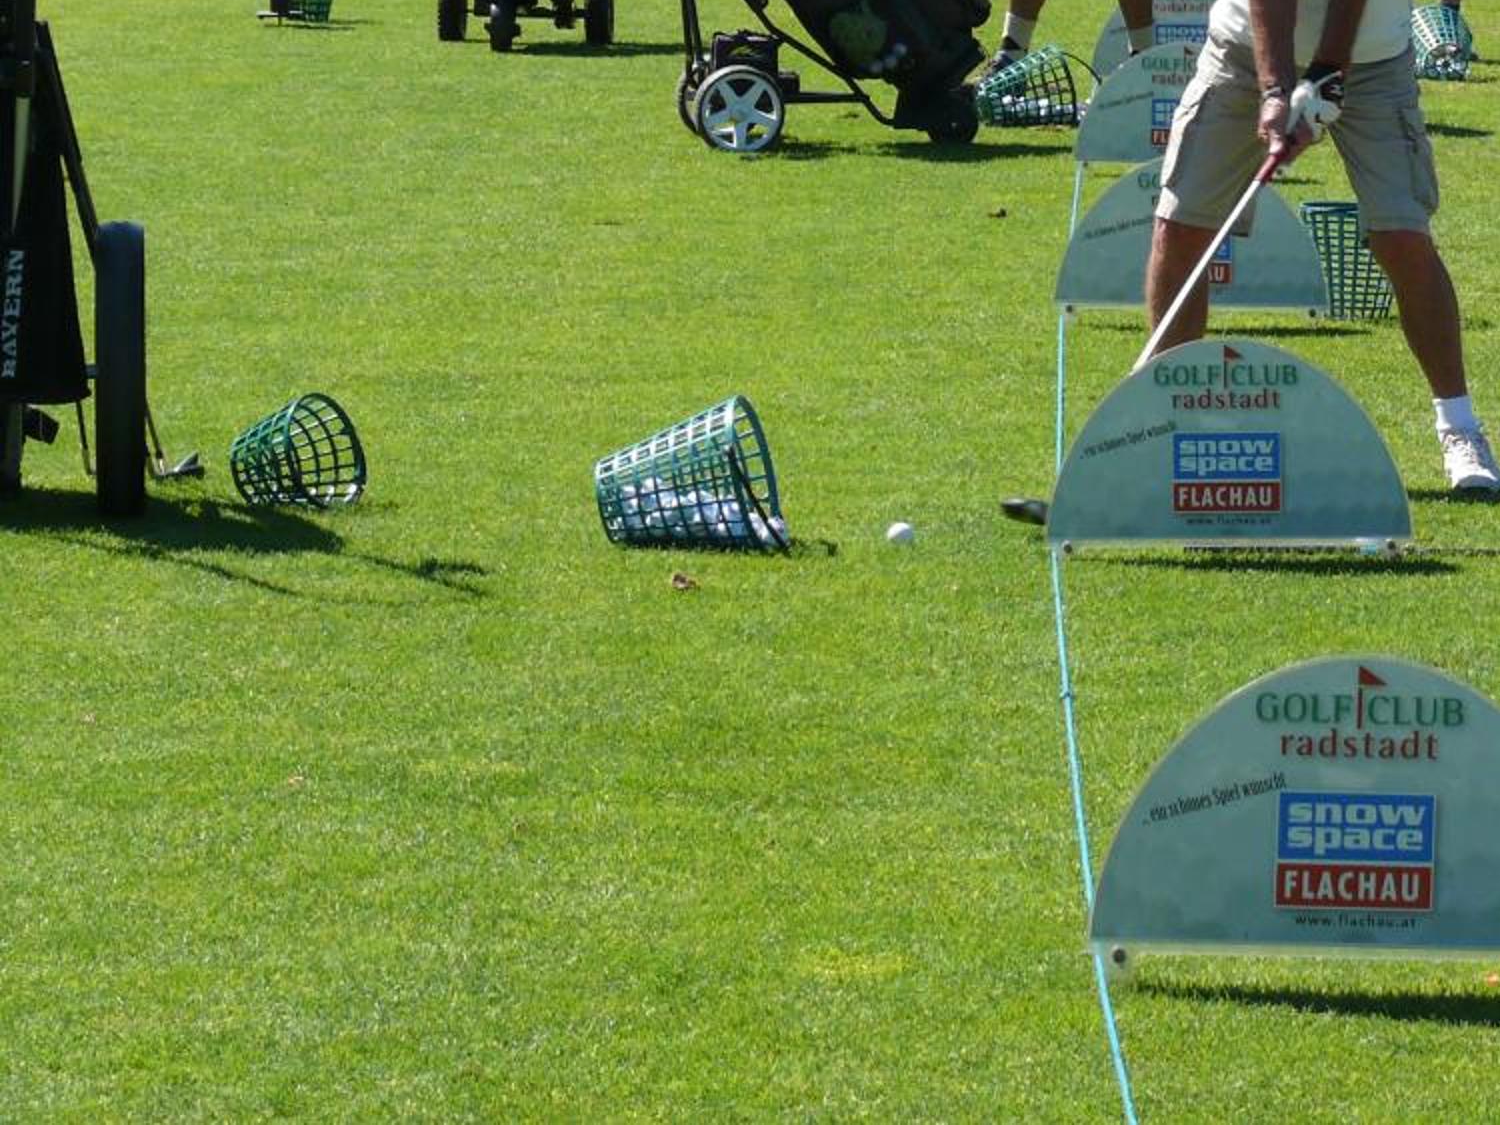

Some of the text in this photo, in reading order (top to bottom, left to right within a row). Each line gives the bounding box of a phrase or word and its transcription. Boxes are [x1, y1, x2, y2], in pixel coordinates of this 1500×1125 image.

[1153, 362, 1298, 387] GOLF CLUB
[1171, 387, 1281, 410] radstadt
[1179, 440, 1275, 455] snow
[1179, 455, 1274, 476] space
[1179, 486, 1272, 508] FLACHAU
[1255, 691, 1465, 727] GOLF CLUB
[1280, 728, 1439, 761] radstadt
[1287, 802, 1427, 826] snow
[1286, 825, 1425, 857] space
[1283, 869, 1421, 903] FLACHAU
[1295, 912, 1417, 930] www.flachau.at
